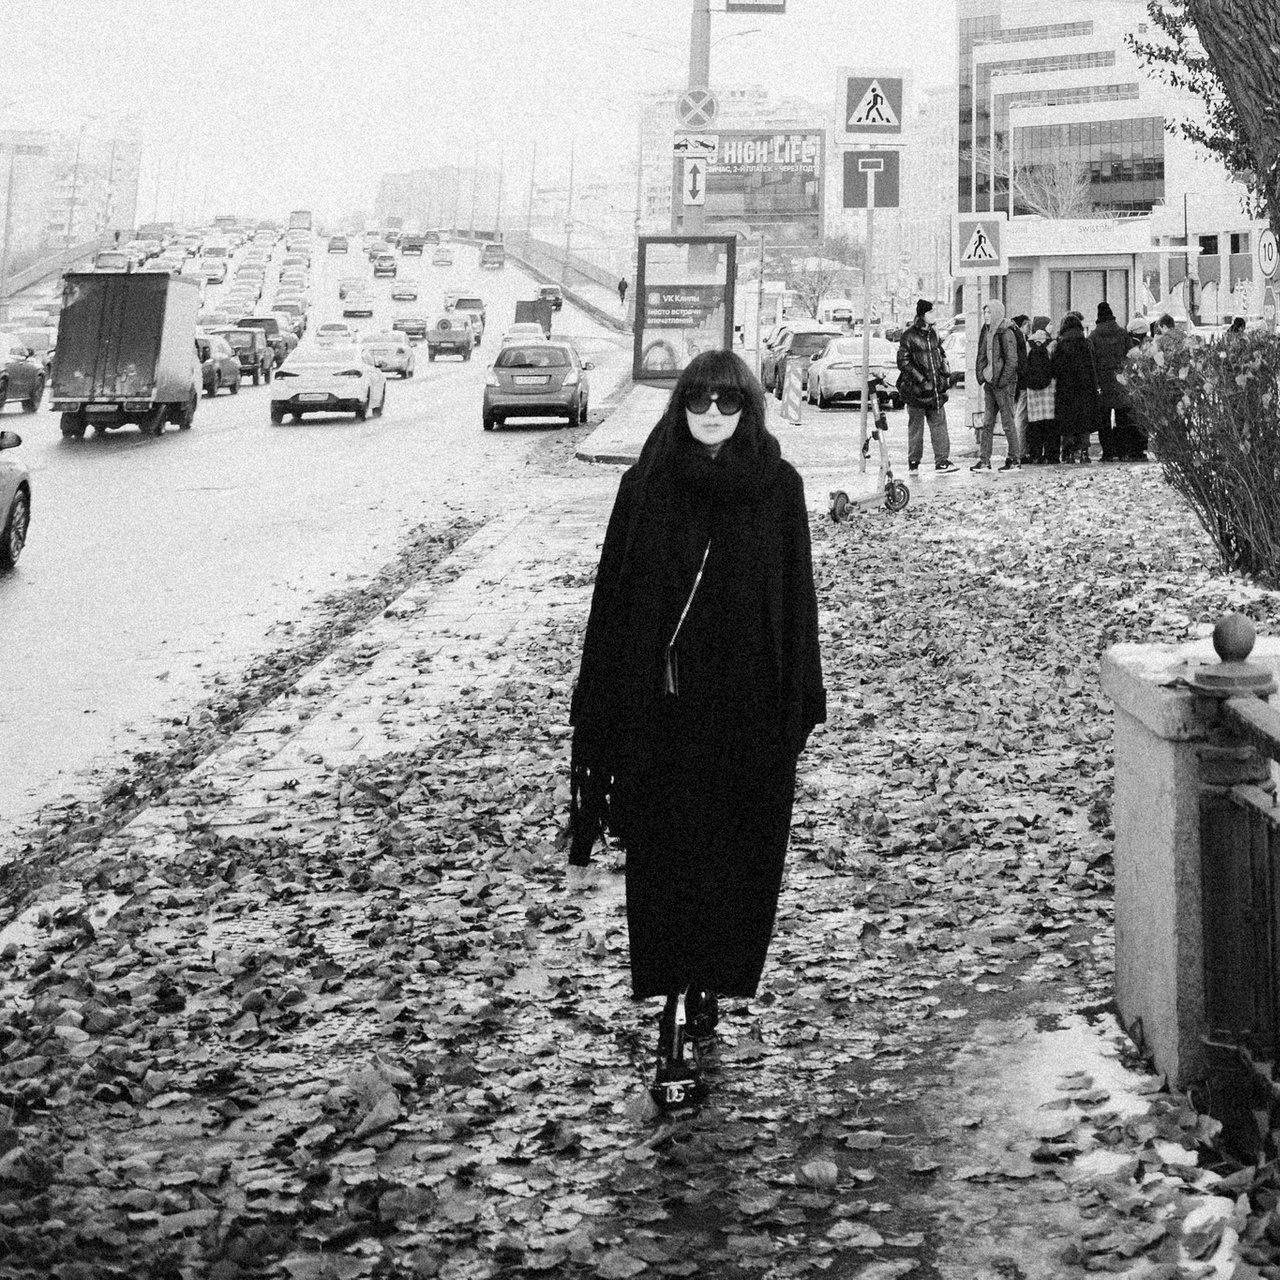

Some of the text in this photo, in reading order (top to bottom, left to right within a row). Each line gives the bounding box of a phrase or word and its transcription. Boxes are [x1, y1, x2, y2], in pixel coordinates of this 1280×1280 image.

[723, 140, 768, 165] HIGH
[1263, 242, 1273, 262] 10
[662, 294, 674, 302] VK
